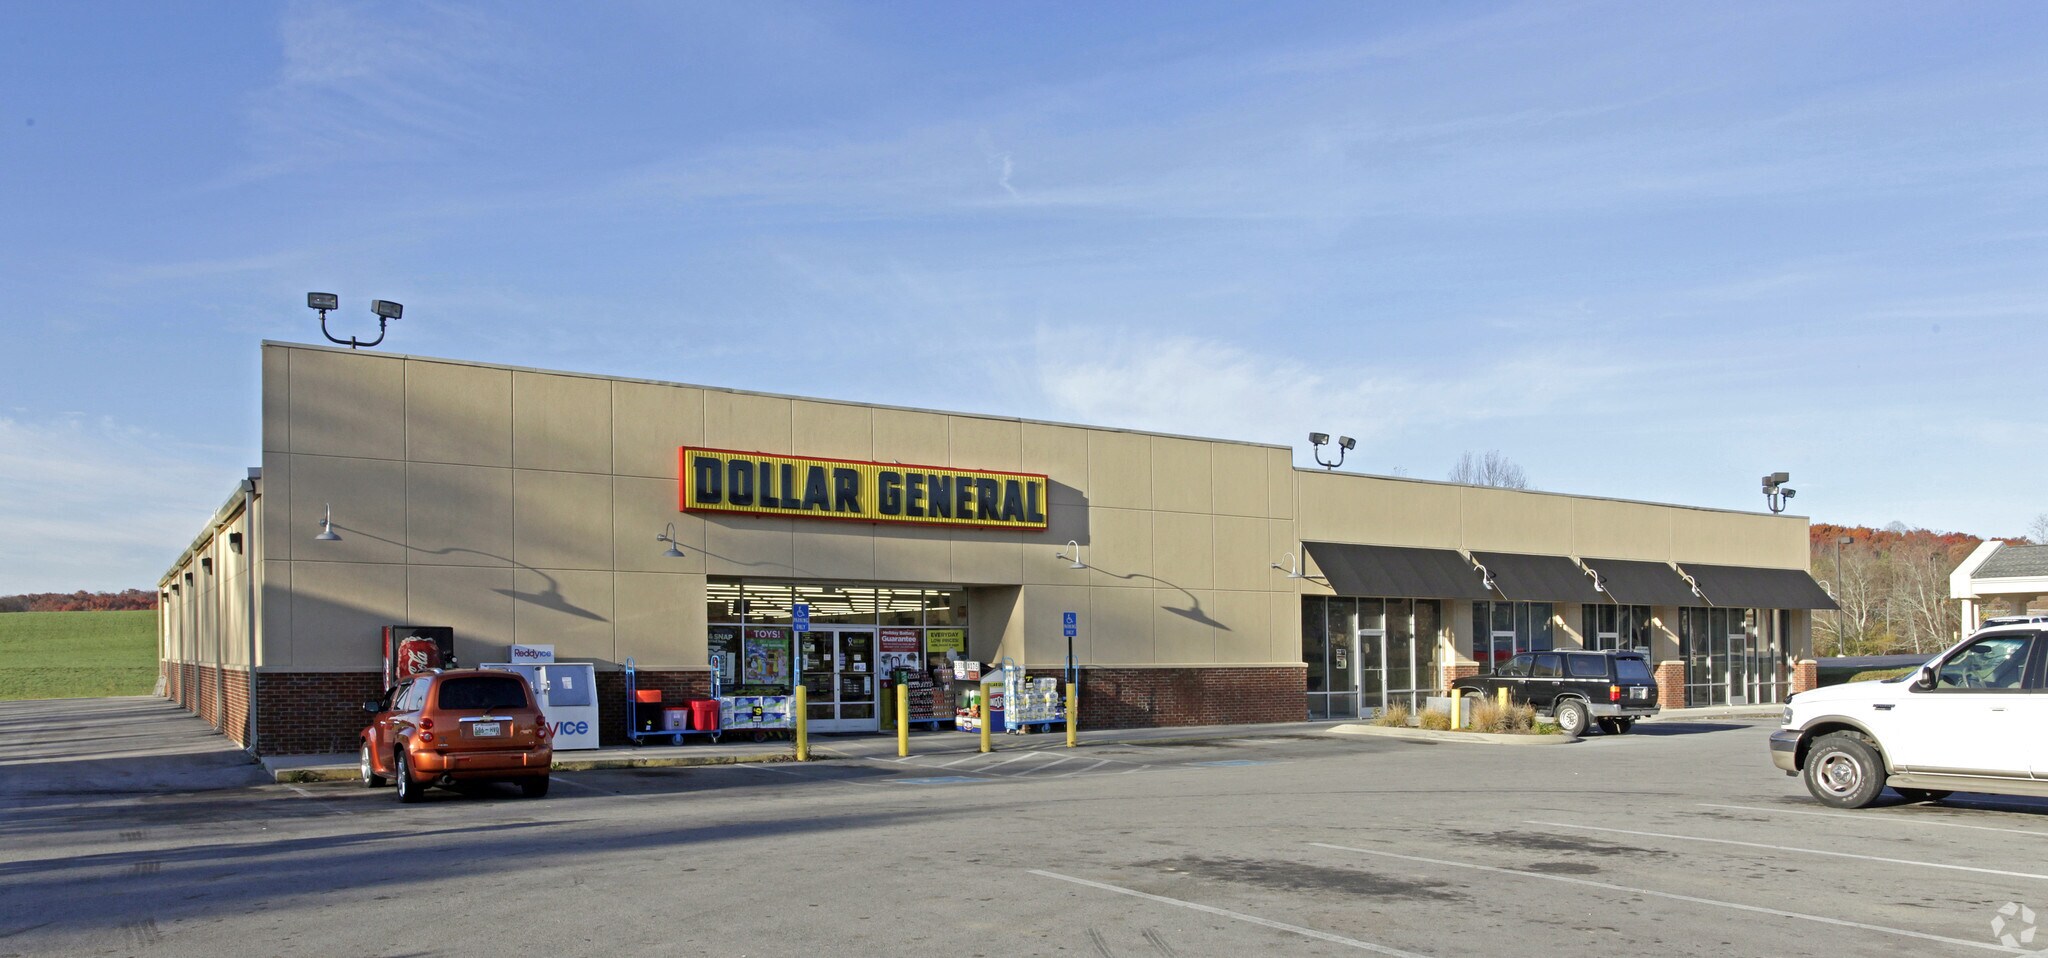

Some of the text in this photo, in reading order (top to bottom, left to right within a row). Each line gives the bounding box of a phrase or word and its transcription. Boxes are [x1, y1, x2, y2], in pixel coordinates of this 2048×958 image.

[694, 456, 1044, 522] DOLLAR GENERAL
[753, 630, 781, 638] TOYS!
[881, 635, 917, 643] Guarantee
